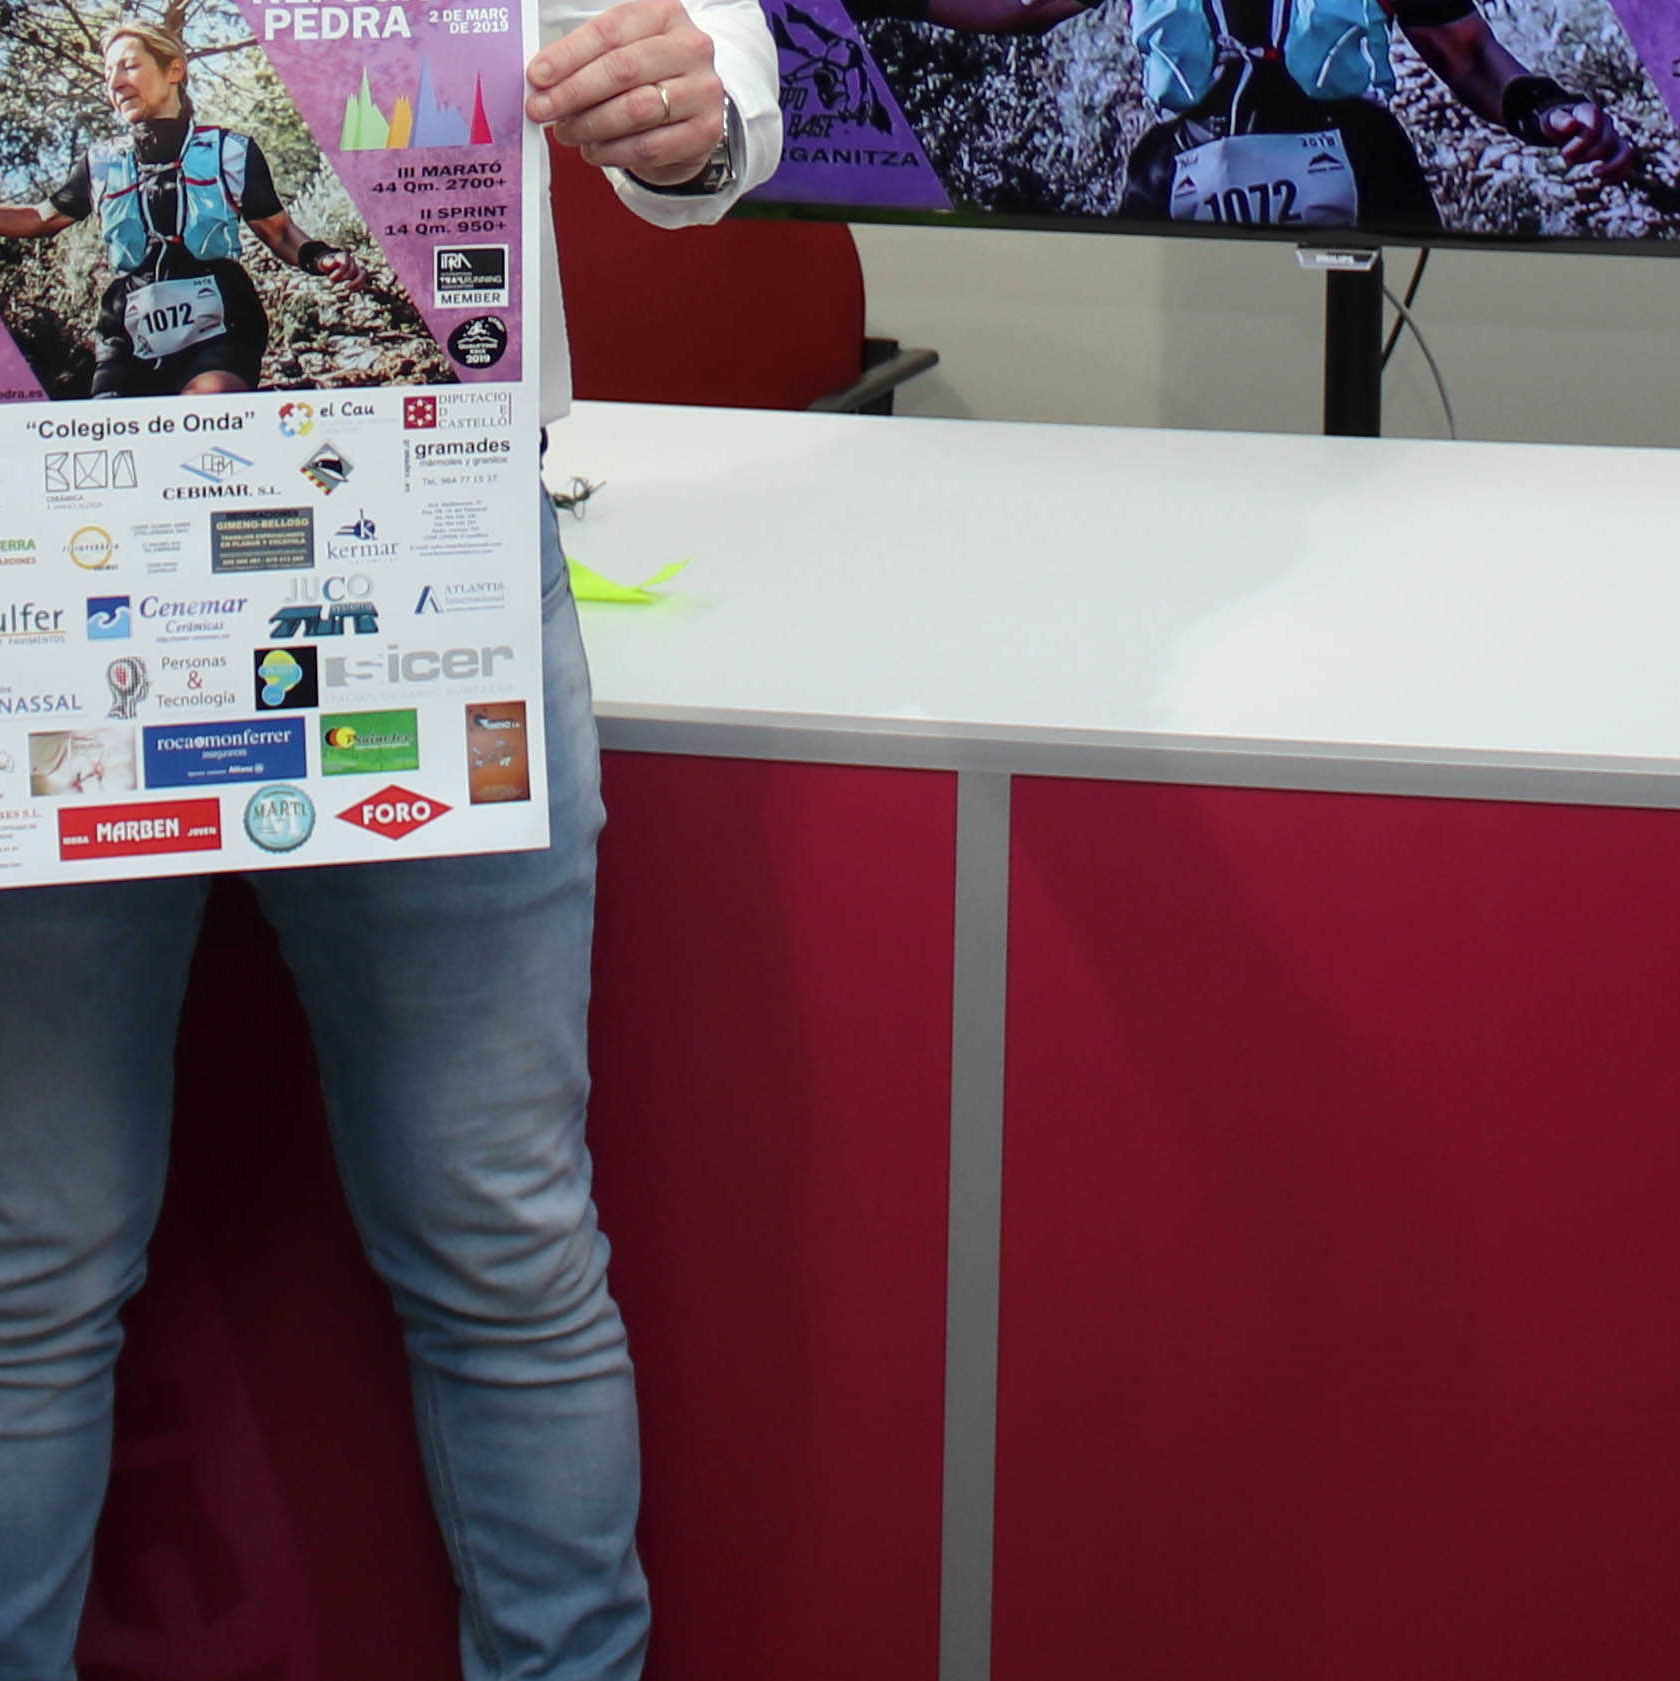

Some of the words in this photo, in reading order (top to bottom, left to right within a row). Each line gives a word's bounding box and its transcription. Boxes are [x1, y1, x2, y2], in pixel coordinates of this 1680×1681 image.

[264, 5, 412, 41] PEDRA
[429, 9, 439, 23] 2
[443, 9, 463, 23] DE
[449, 21, 470, 34] DE
[472, 20, 509, 33] 2019
[782, 147, 920, 167] GANITZA
[398, 166, 415, 179] III
[421, 162, 502, 177] MARATÓ
[372, 181, 397, 193] 44
[446, 177, 507, 191] 2700+
[1203, 179, 1302, 224] 1072
[420, 208, 431, 220] II
[438, 205, 508, 219] SPRINT
[385, 224, 408, 236] 14
[457, 220, 507, 233] 950+
[441, 292, 501, 305] MEMBER
[142, 302, 195, 334] 1072
[319, 401, 335, 417] el
[341, 402, 375, 417] Cau
[25, 417, 140, 442] “Colegios
[147, 415, 175, 435] de
[182, 411, 256, 434] Onda”
[415, 437, 511, 459] gramades
[327, 540, 399, 560] kermar
[140, 595, 248, 619] Cenemar
[161, 656, 227, 670] Personas
[187, 670, 204, 689] &
[158, 691, 237, 708] Tecnología
[361, 800, 432, 825] FORO
[96, 817, 180, 843] MARBEN
